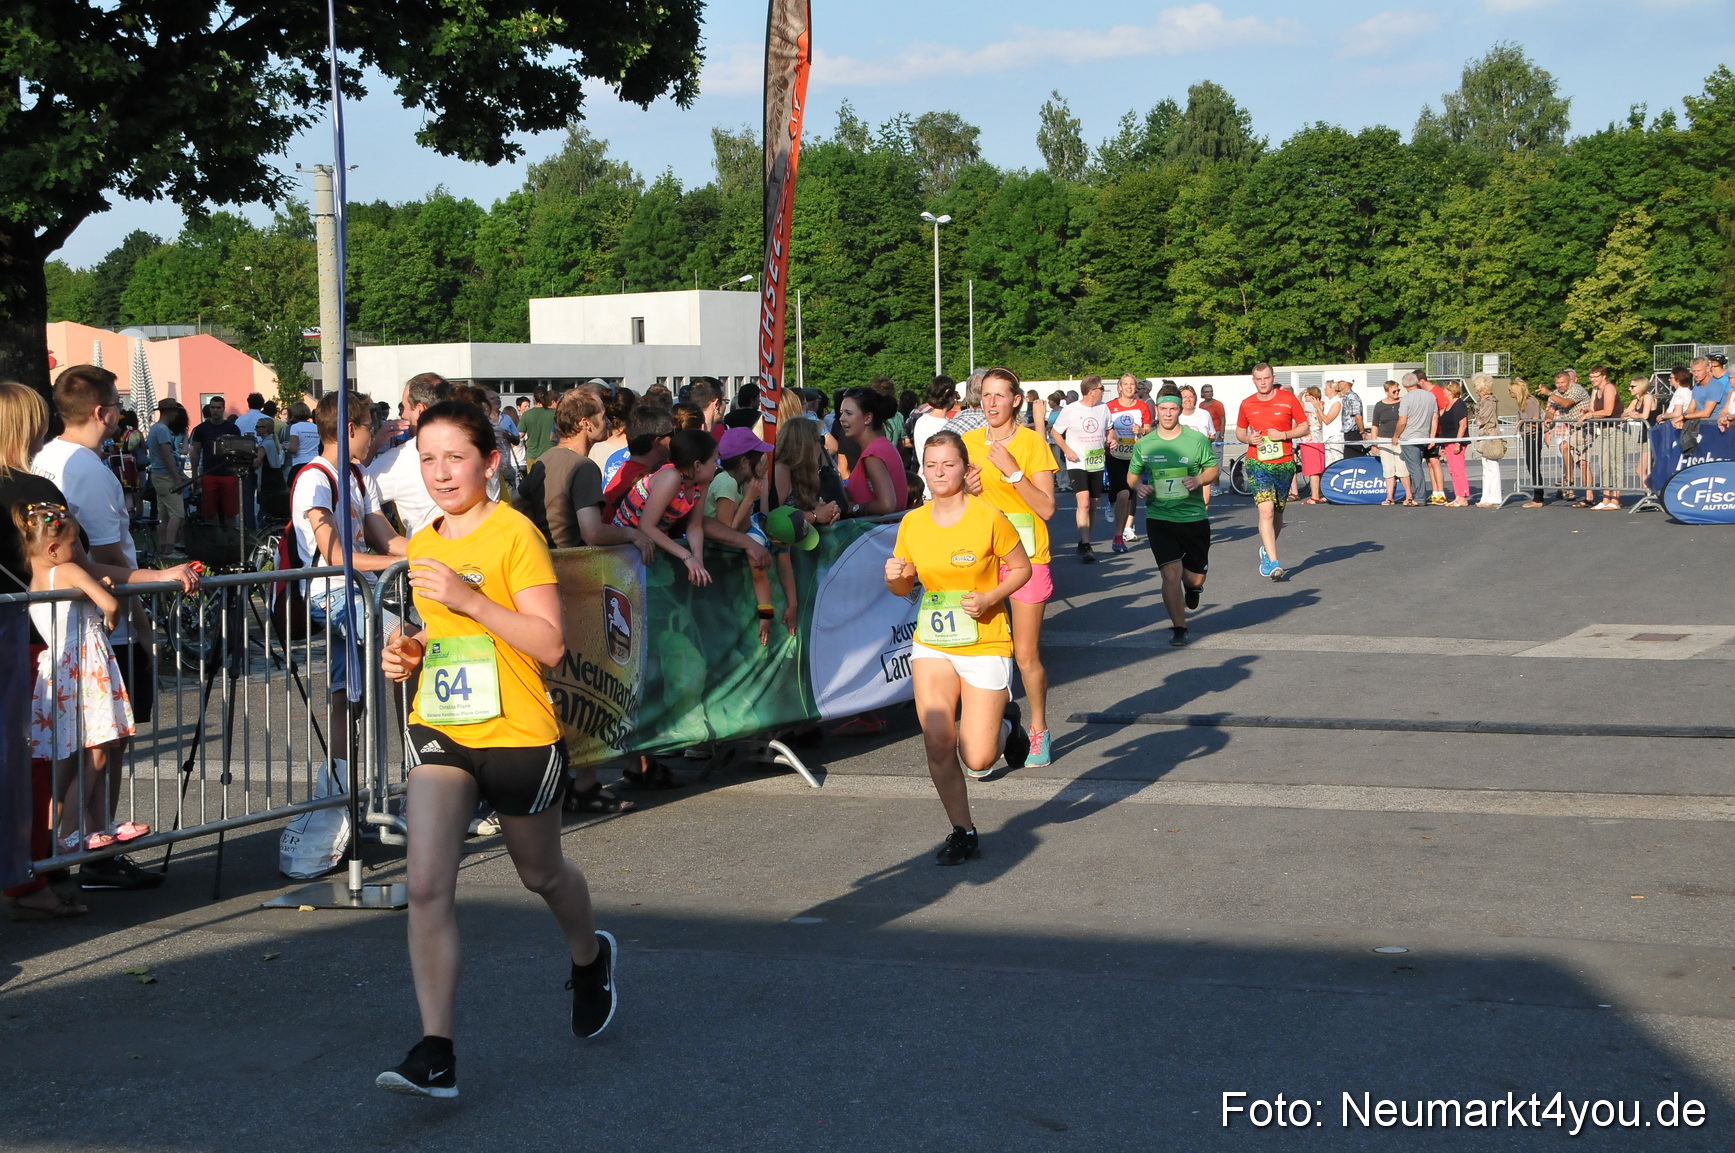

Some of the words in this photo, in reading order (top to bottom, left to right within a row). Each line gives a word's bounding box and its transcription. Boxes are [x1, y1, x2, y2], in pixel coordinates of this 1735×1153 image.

[1116, 444, 1133, 453] 028
[1166, 480, 1174, 492] 7
[1343, 477, 1387, 490] Fisch
[1694, 490, 1735, 504] Fisc
[1702, 503, 1735, 511] AUTOM
[931, 610, 956, 633] 61
[435, 667, 473, 703] 64
